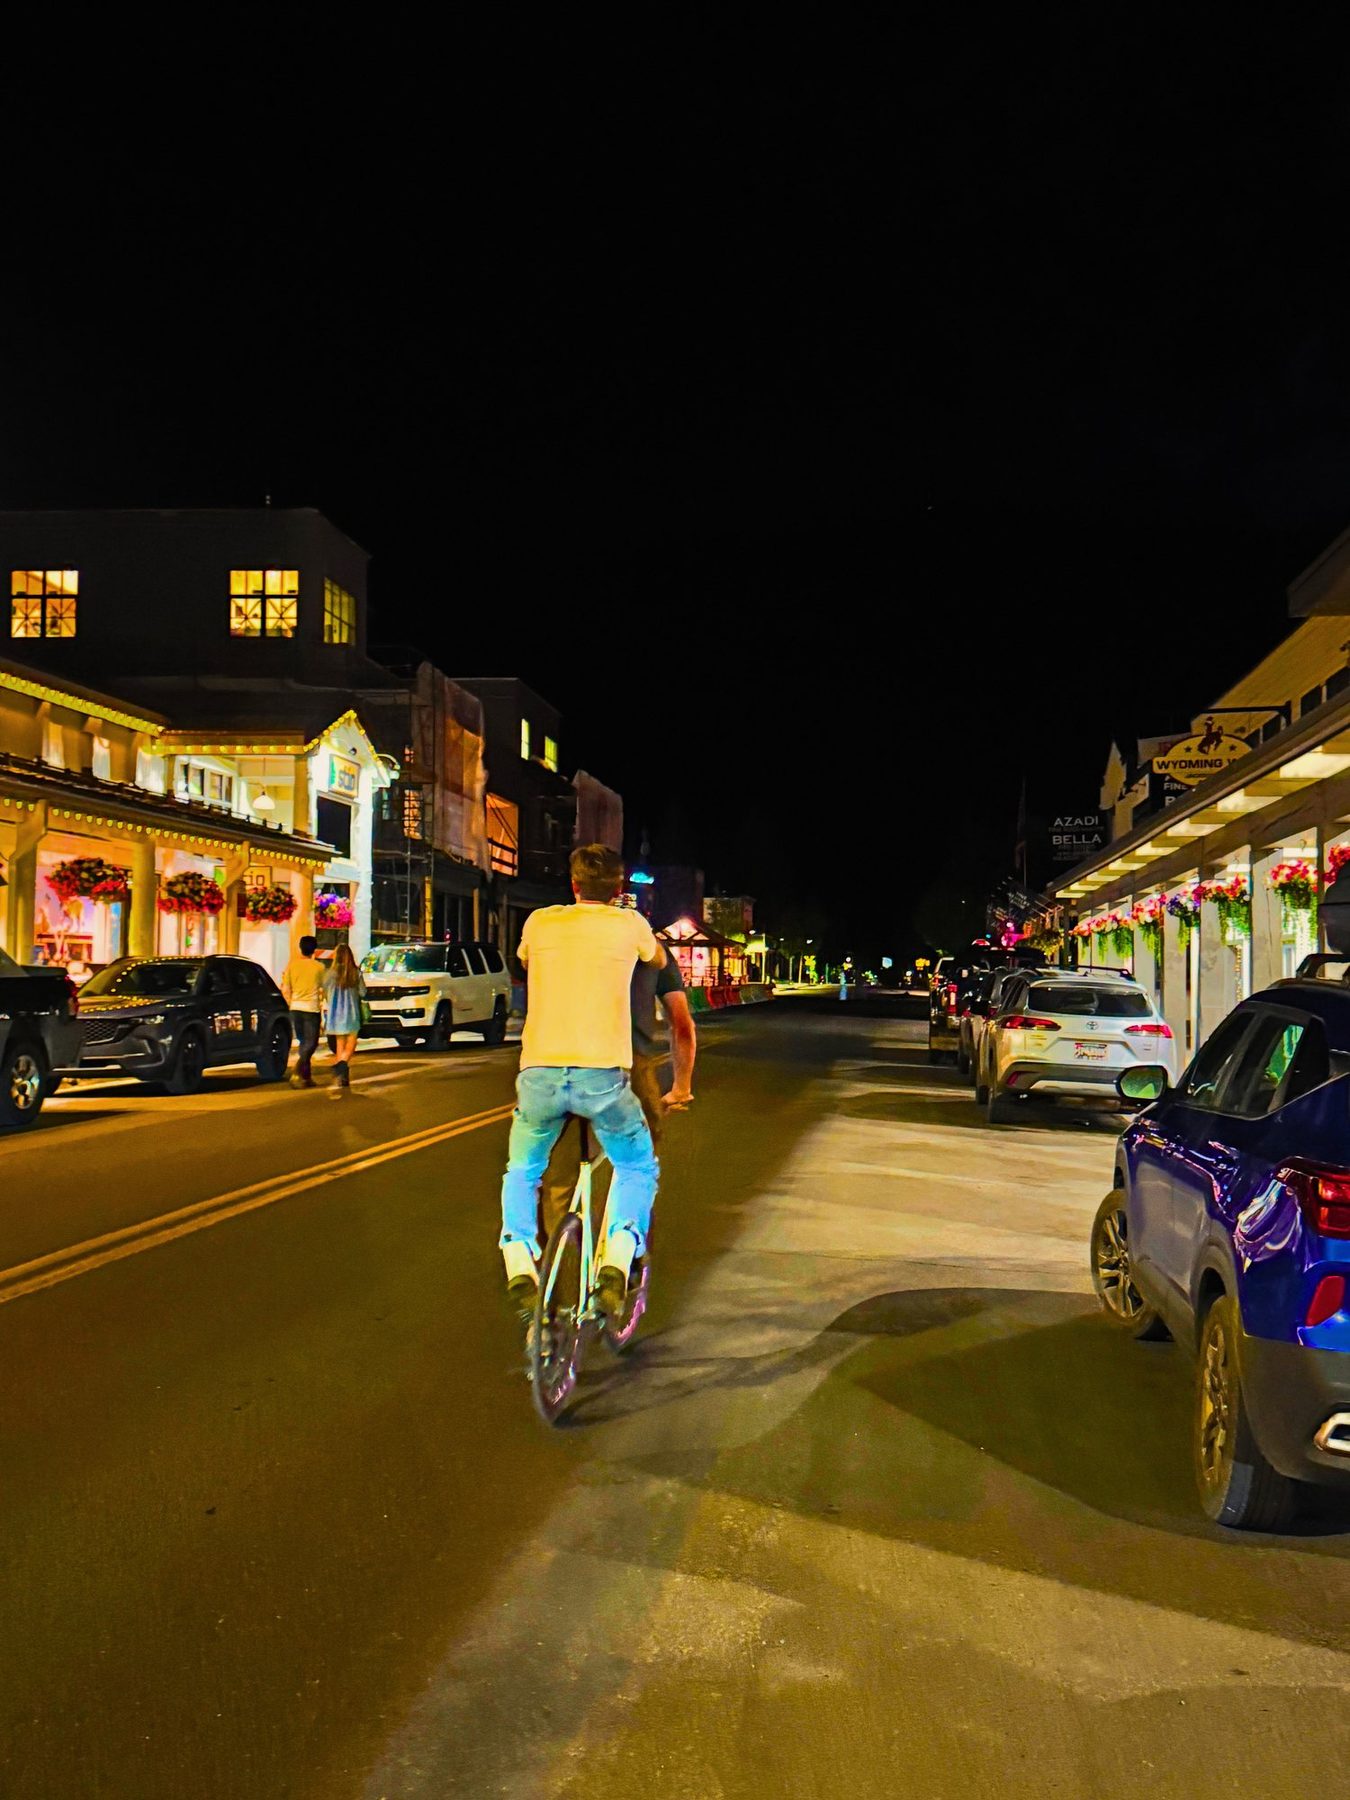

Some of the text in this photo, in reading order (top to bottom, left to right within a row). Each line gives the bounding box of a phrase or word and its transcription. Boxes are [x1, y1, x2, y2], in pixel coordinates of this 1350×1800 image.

[1156, 758, 1222, 770] WYOMING
[1053, 815, 1099, 827] AZADI
[1052, 833, 1102, 846] BELLA
